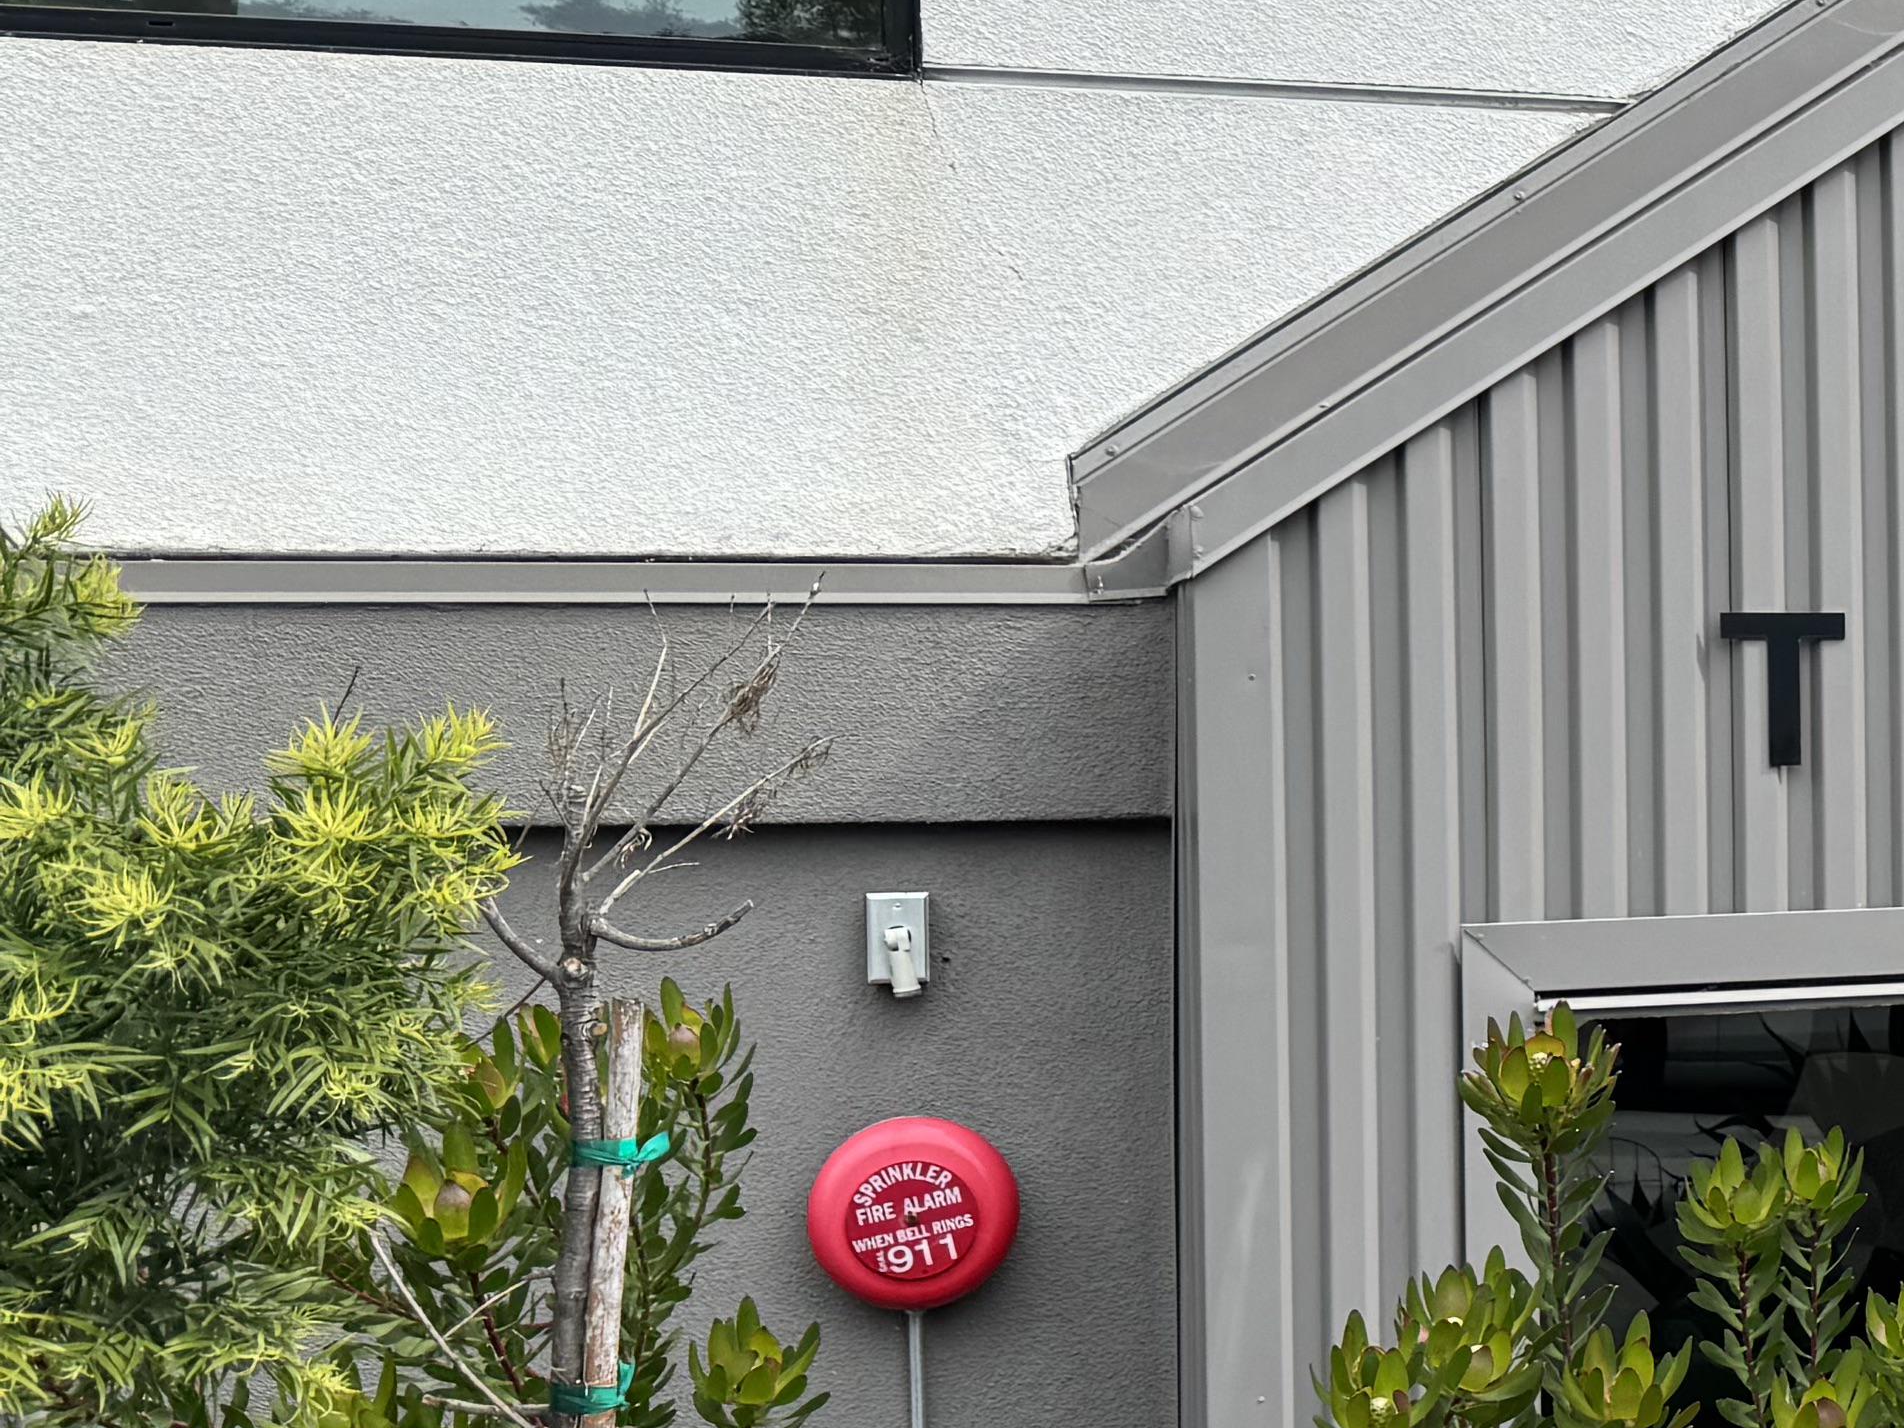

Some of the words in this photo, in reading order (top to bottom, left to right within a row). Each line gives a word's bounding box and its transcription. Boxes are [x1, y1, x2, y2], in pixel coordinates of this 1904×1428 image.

[853, 1162, 952, 1207] SPRINKLER
[855, 1202, 896, 1226] FIRE
[904, 1186, 963, 1215] ALARM
[852, 1232, 895, 1253] WHEN
[896, 1223, 930, 1243] BELL
[932, 1213, 974, 1235] RINGS
[887, 1233, 958, 1274] 911
